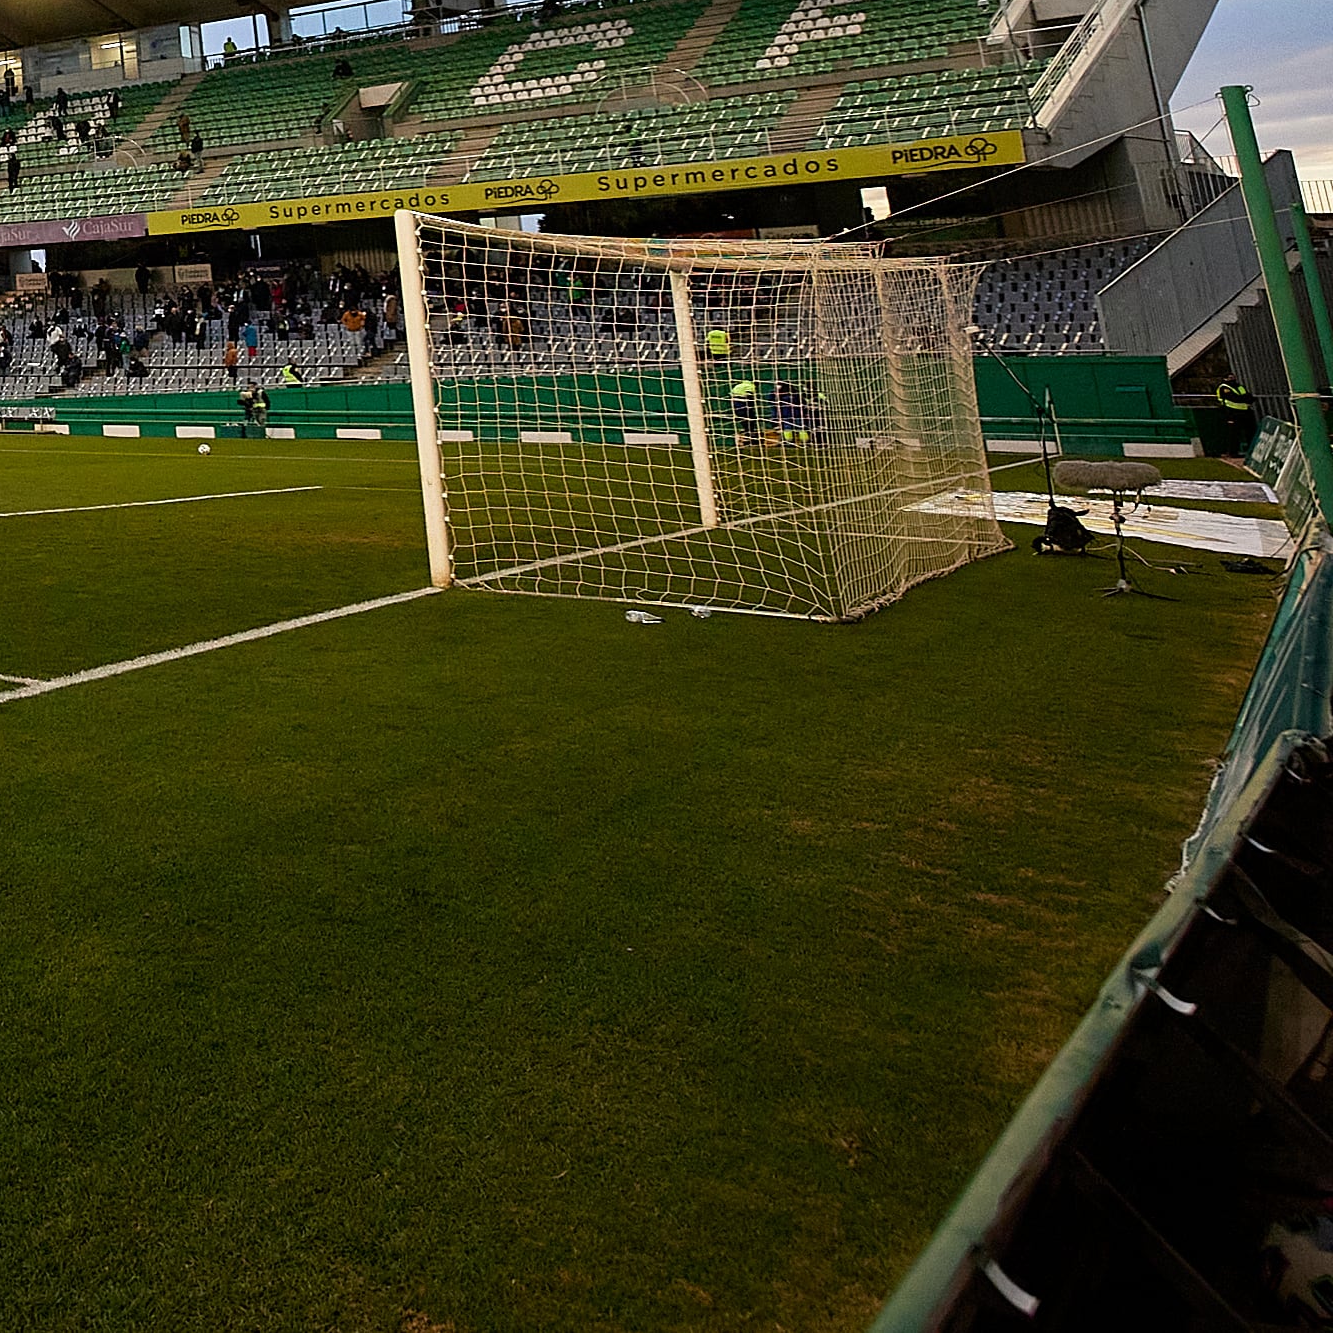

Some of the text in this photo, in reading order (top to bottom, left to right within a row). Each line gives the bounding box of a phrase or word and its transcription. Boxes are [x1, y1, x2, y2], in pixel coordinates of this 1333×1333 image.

[597, 154, 840, 193] Supermercados
[269, 192, 450, 220] Supermercados
[82, 219, 135, 236] CajaSur
